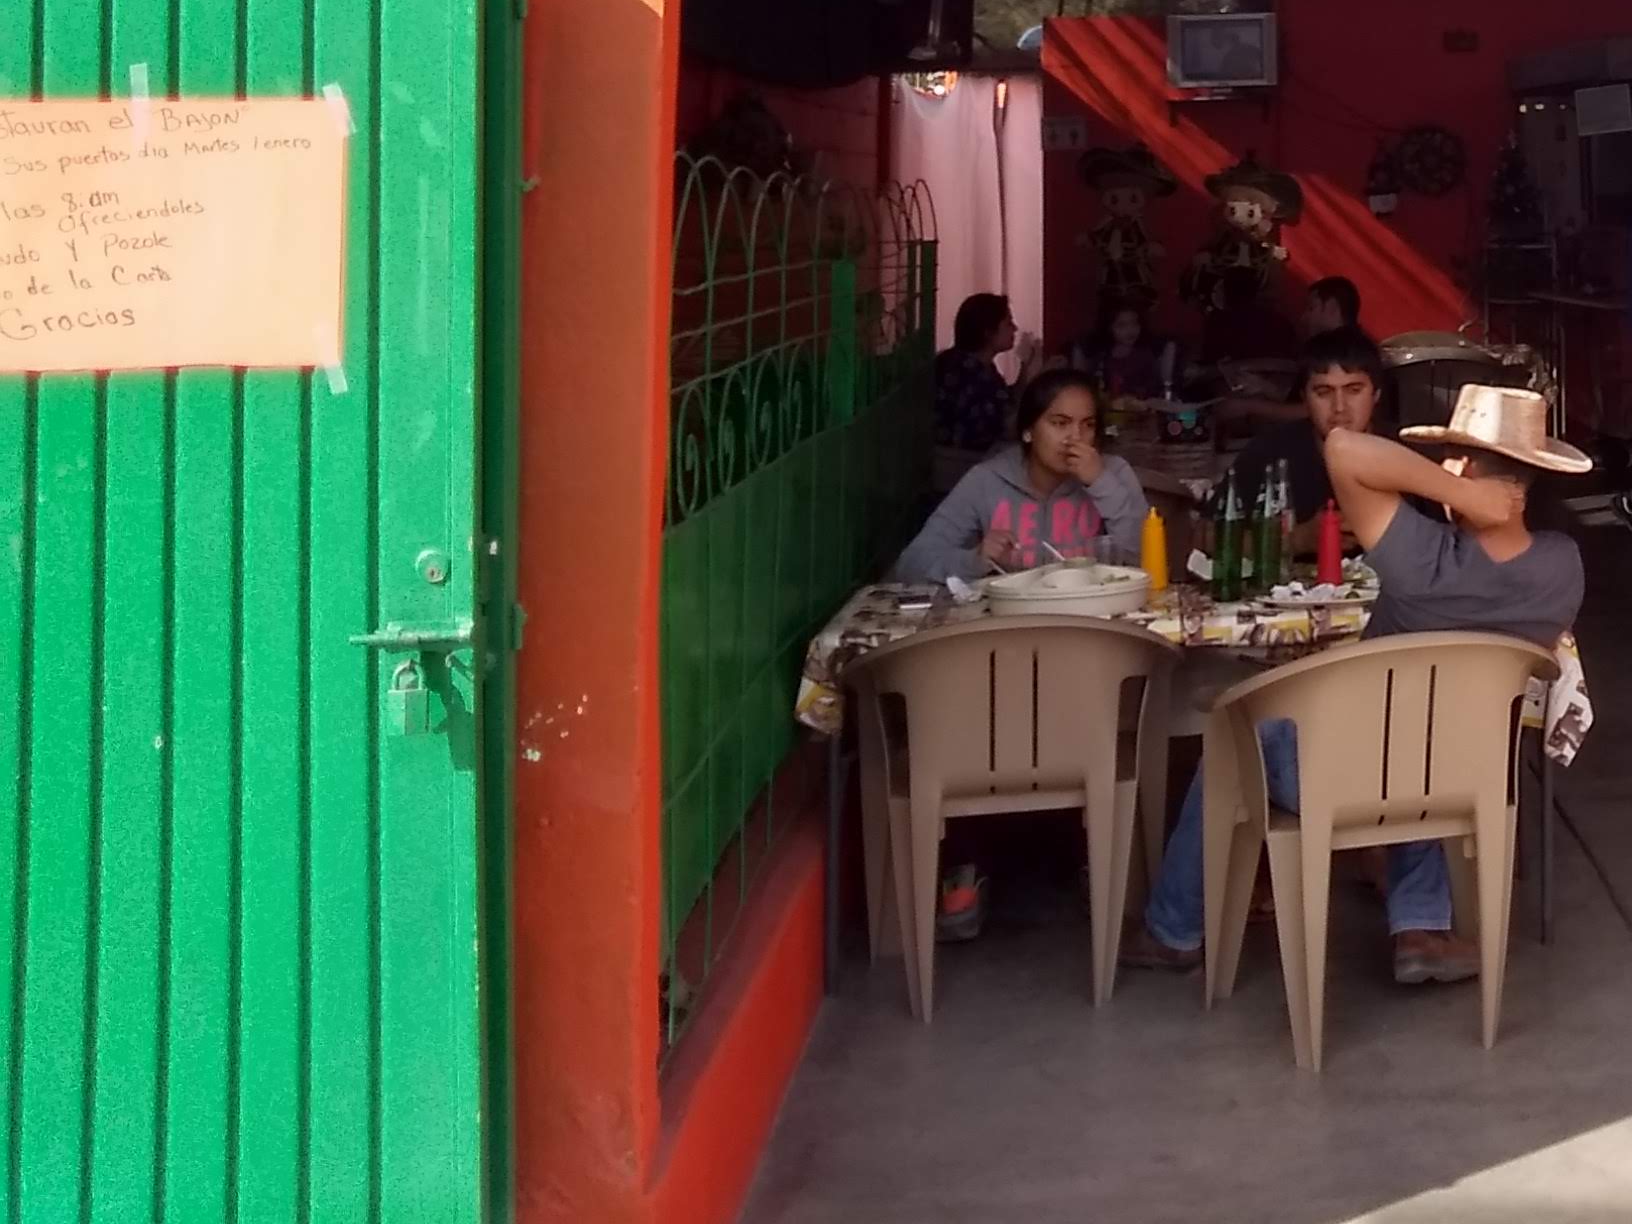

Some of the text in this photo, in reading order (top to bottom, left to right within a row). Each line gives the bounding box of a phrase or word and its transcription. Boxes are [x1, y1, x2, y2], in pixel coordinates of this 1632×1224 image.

[109, 107, 134, 129] el
[27, 275, 54, 295] de
[68, 269, 93, 289] la
